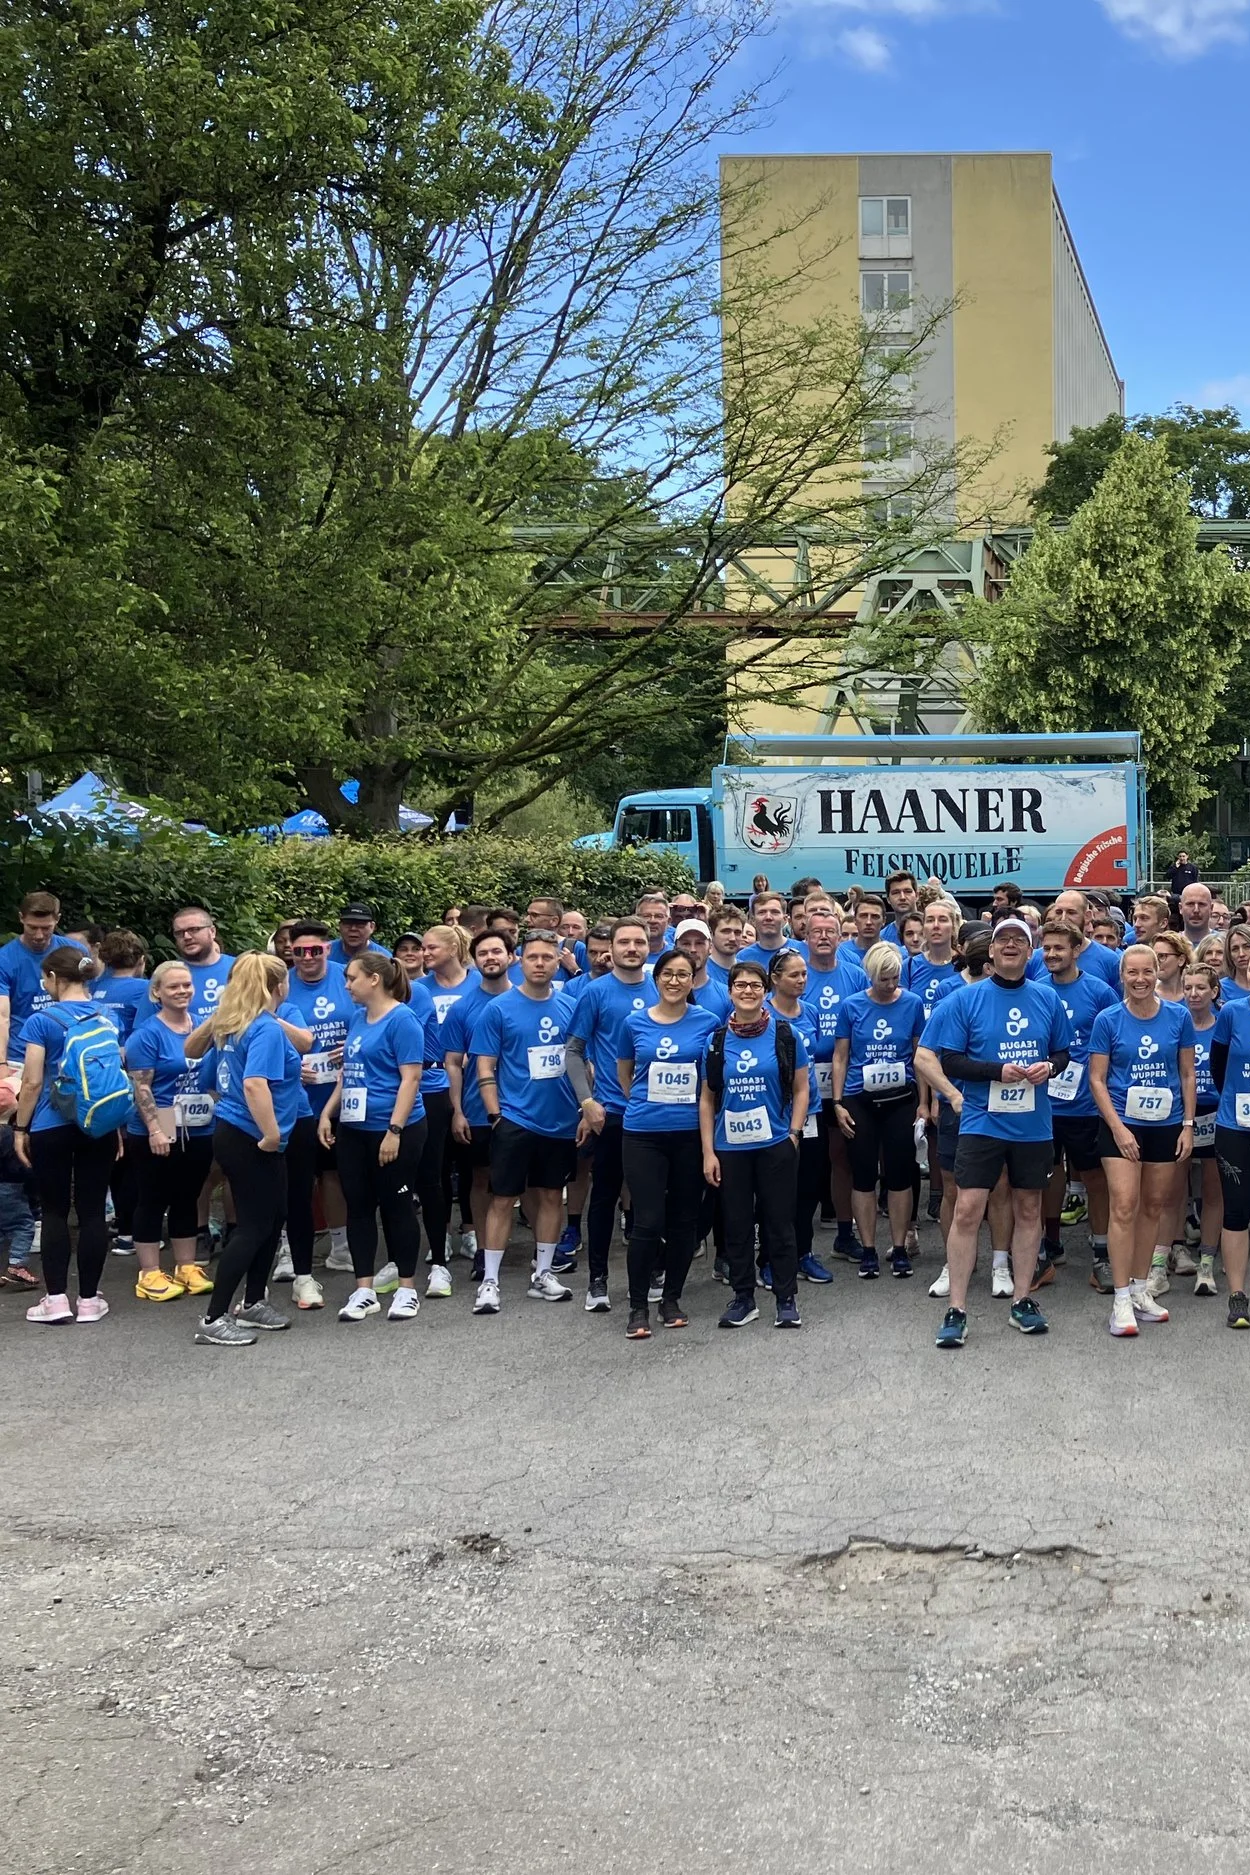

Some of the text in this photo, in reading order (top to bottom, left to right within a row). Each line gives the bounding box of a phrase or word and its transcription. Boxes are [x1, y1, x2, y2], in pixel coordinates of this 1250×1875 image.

[816, 788, 1047, 834] HAANER
[1073, 835, 1123, 884] Bergische Frische
[844, 847, 1021, 885] FELSENQUELLE
[33, 994, 52, 1003] BUG
[320, 1038, 338, 1047] TAL
[1000, 1040, 1037, 1050] BUGA31
[539, 1054, 561, 1067] 798
[865, 1051, 897, 1059] WUPPER
[998, 1050, 1039, 1060] WUPPER
[1132, 1062, 1165, 1072] BUGA31
[656, 1072, 690, 1085] 1045
[870, 1071, 900, 1084] 1713
[1130, 1070, 1167, 1080] WUPPER
[729, 1076, 765, 1086] BUGA31
[727, 1084, 767, 1094] WUPPER
[1001, 1088, 1026, 1101] 827
[739, 1093, 757, 1101] TAL
[1138, 1096, 1163, 1109] 757
[183, 1103, 209, 1115] 1020
[729, 1118, 763, 1133] 5043
